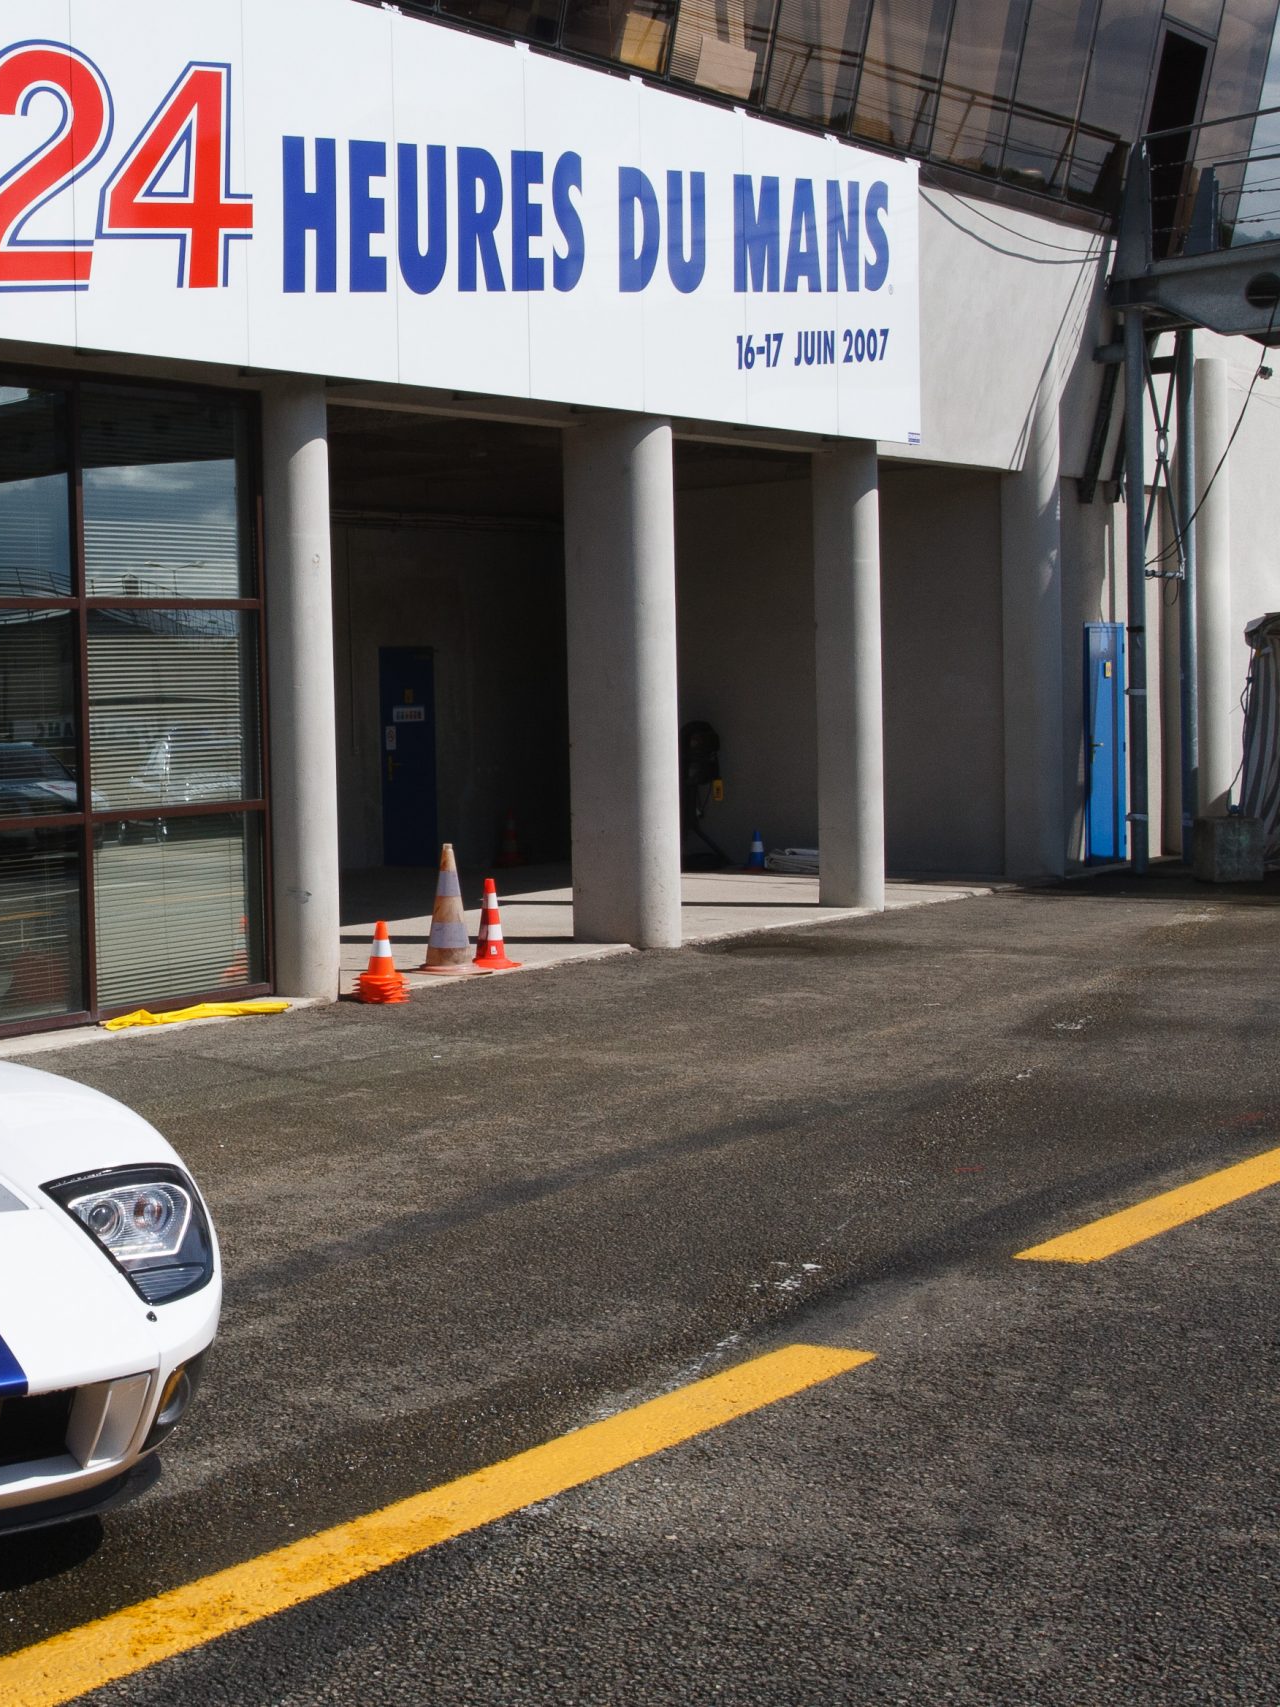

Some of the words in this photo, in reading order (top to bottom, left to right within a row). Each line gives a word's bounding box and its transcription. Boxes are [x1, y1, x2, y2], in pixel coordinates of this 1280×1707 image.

[282, 135, 585, 295] HEURES
[618, 166, 706, 294] DU
[733, 174, 889, 293] MANS
[736, 333, 784, 370] 16-17
[794, 330, 835, 366] JUIN
[842, 328, 889, 363] 2007
